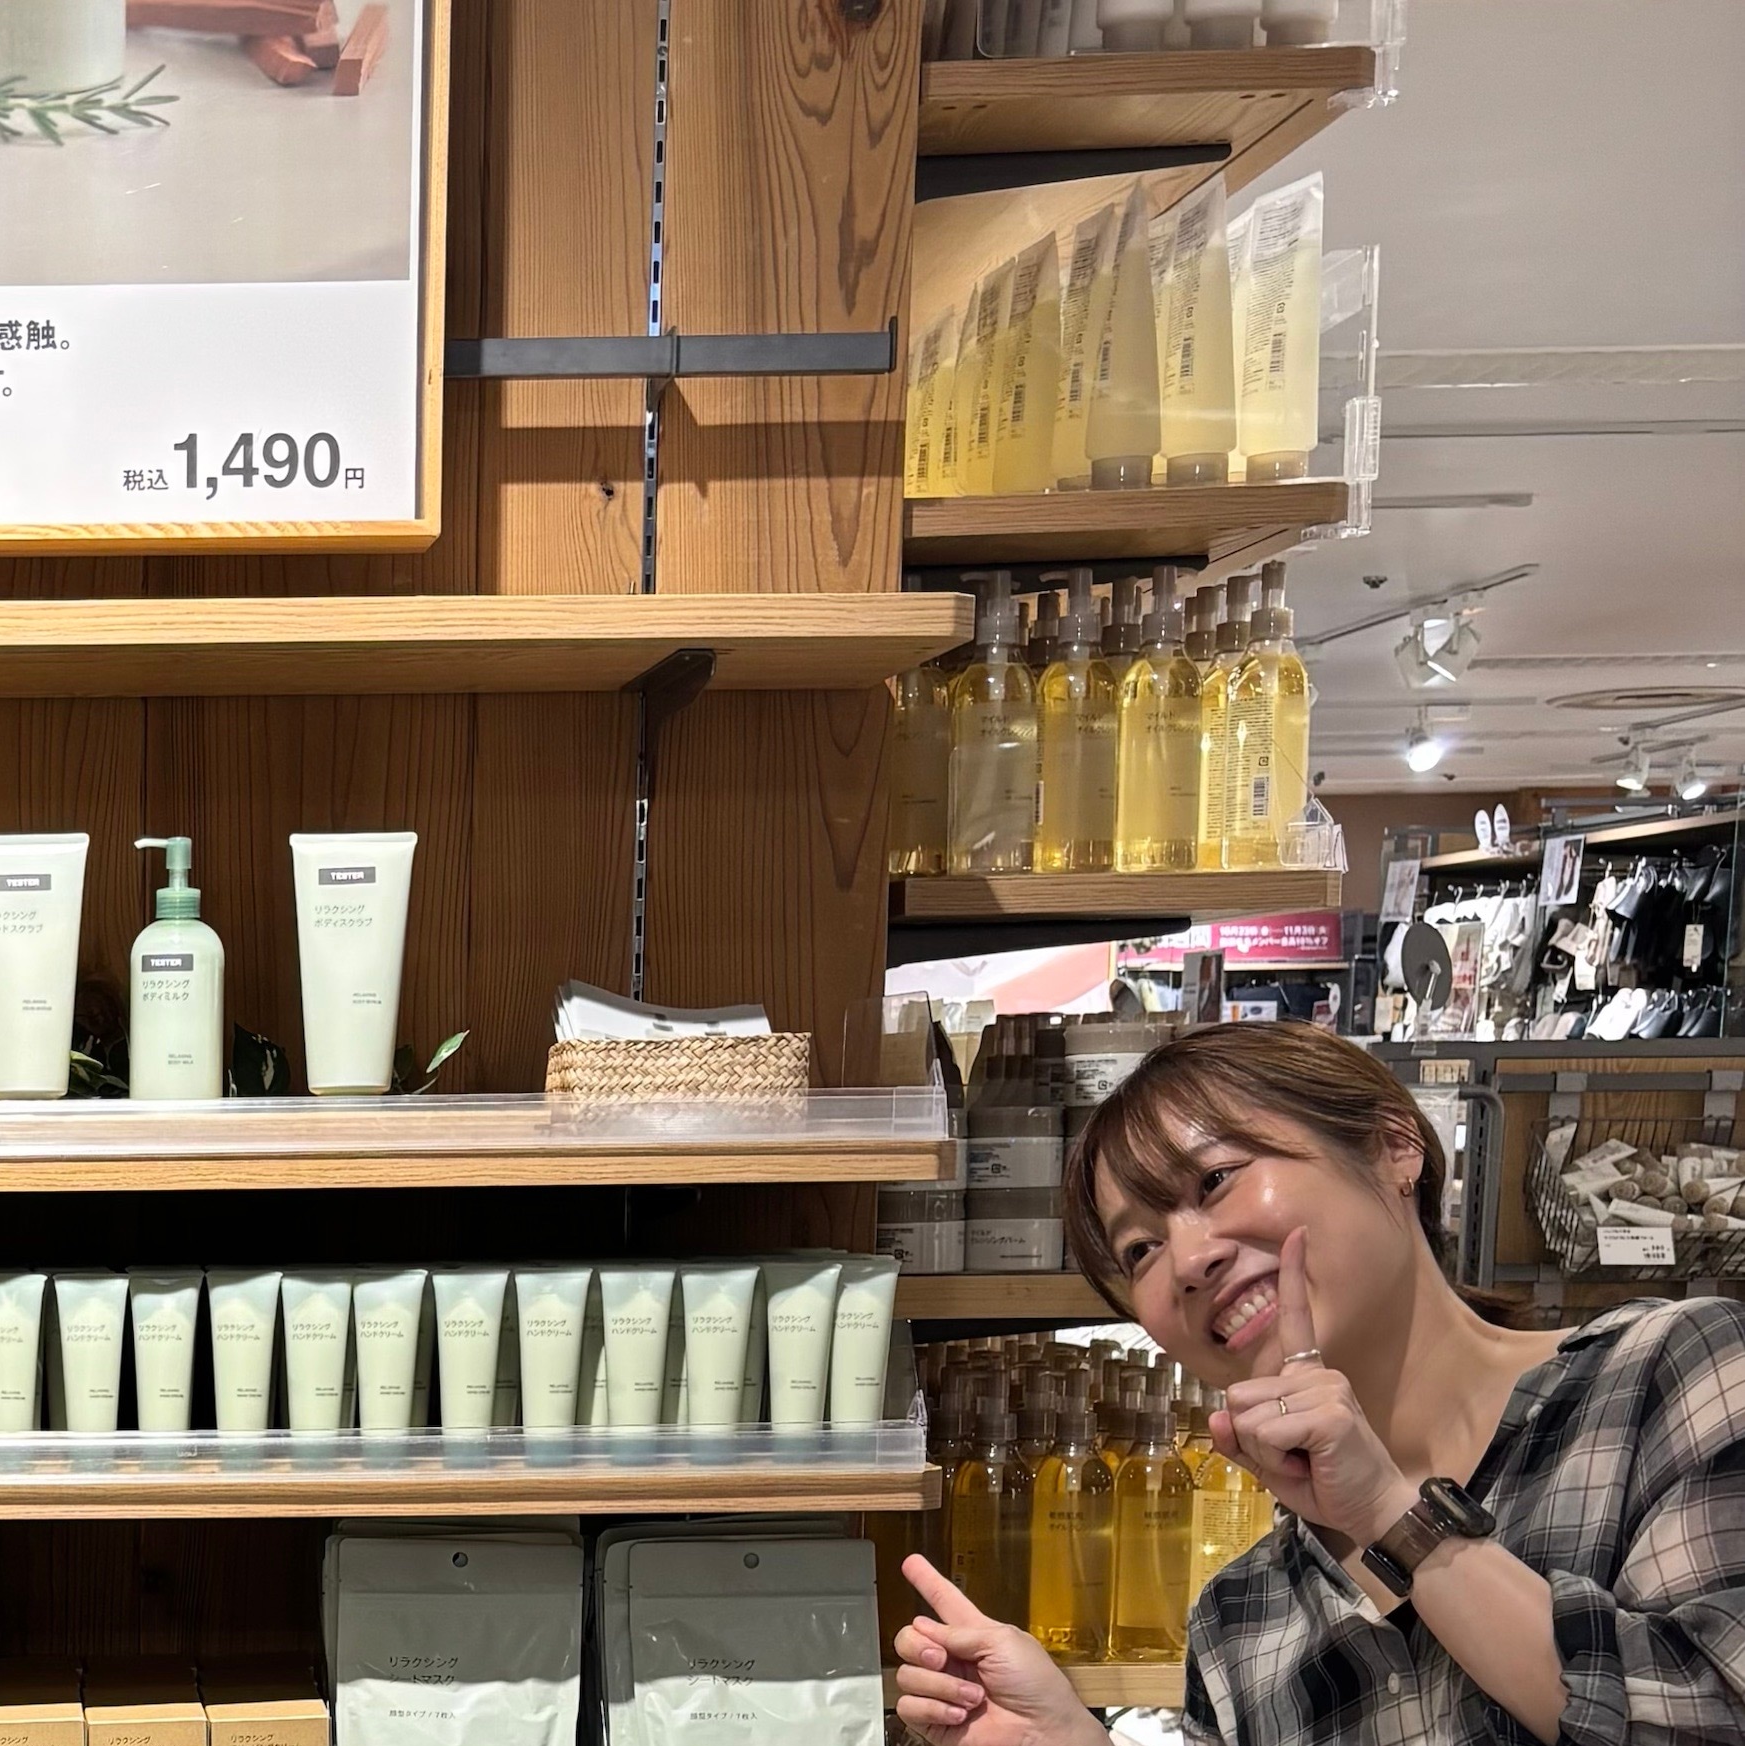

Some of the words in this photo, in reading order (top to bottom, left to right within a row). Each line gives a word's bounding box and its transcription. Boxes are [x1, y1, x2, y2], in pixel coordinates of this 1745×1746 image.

[143, 979, 190, 989] リラクシング
[143, 992, 189, 1001] ボディミルク
[390, 1657, 458, 1668] リラクシング
[389, 1674, 455, 1687] シートマスク
[687, 1676, 754, 1686] シートマスク
